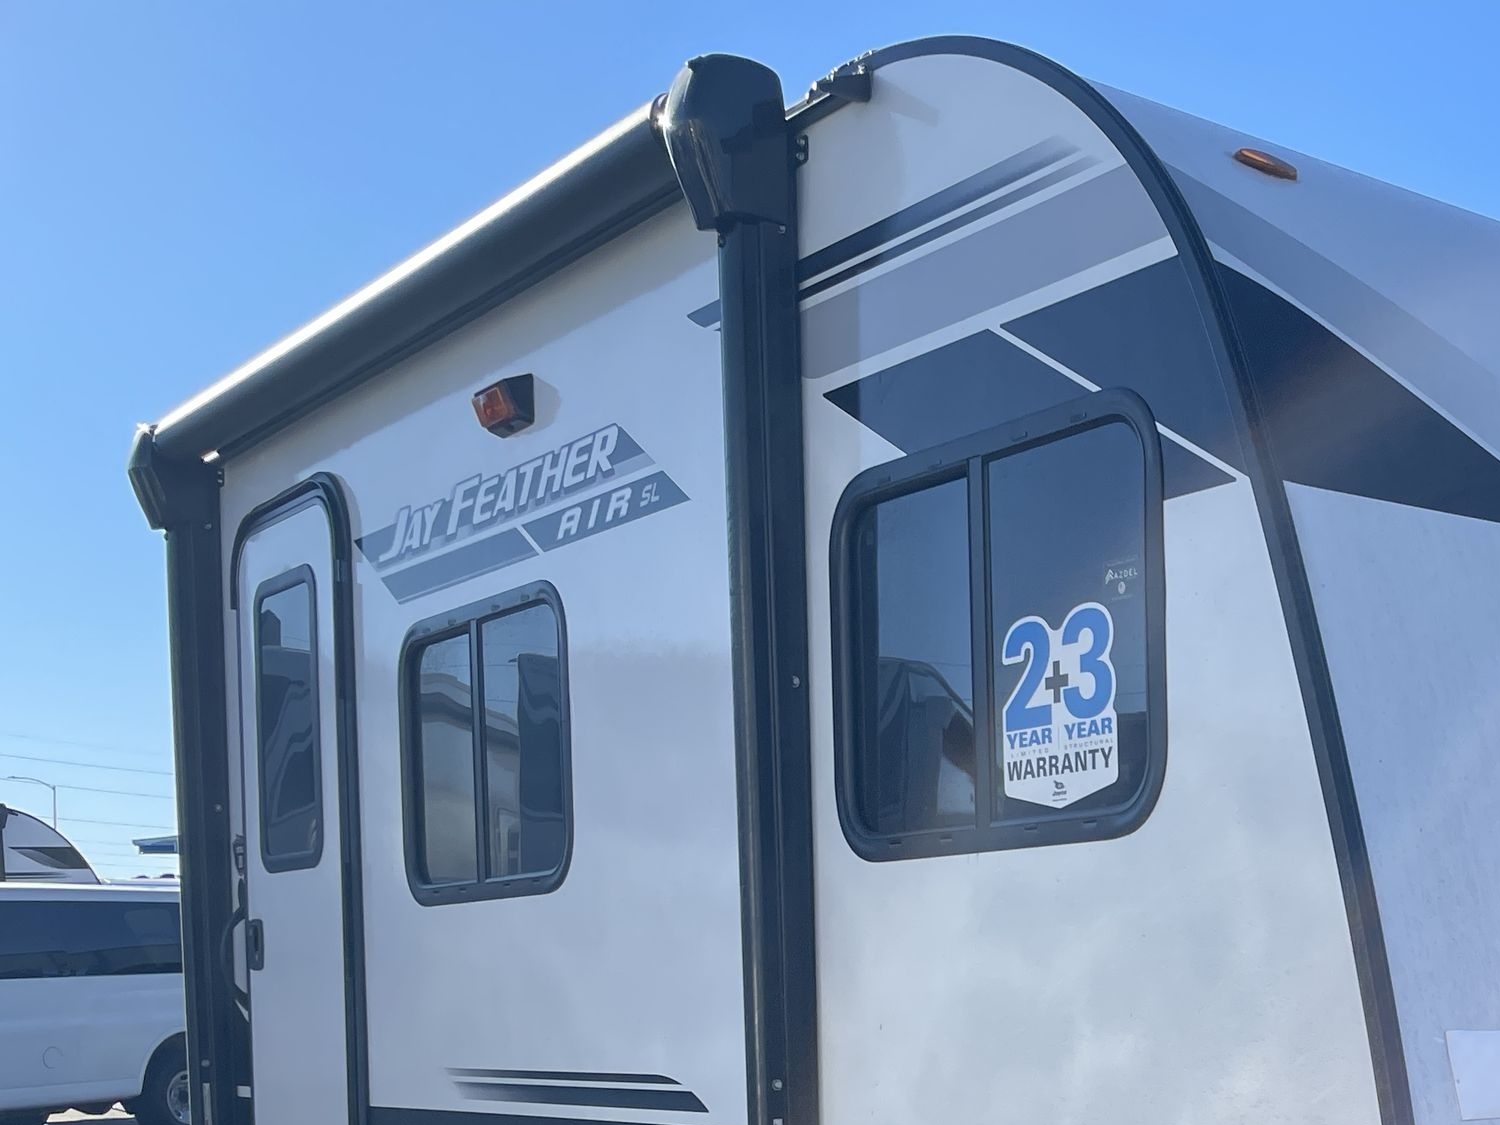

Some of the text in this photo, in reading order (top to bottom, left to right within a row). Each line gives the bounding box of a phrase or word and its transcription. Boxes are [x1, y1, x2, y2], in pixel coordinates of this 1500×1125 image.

[379, 423, 620, 563] JAY FEATHER
[557, 482, 660, 541] AIR SL
[1006, 716, 1113, 750] YEAR YEAR
[1007, 746, 1113, 782] WARRANTY
